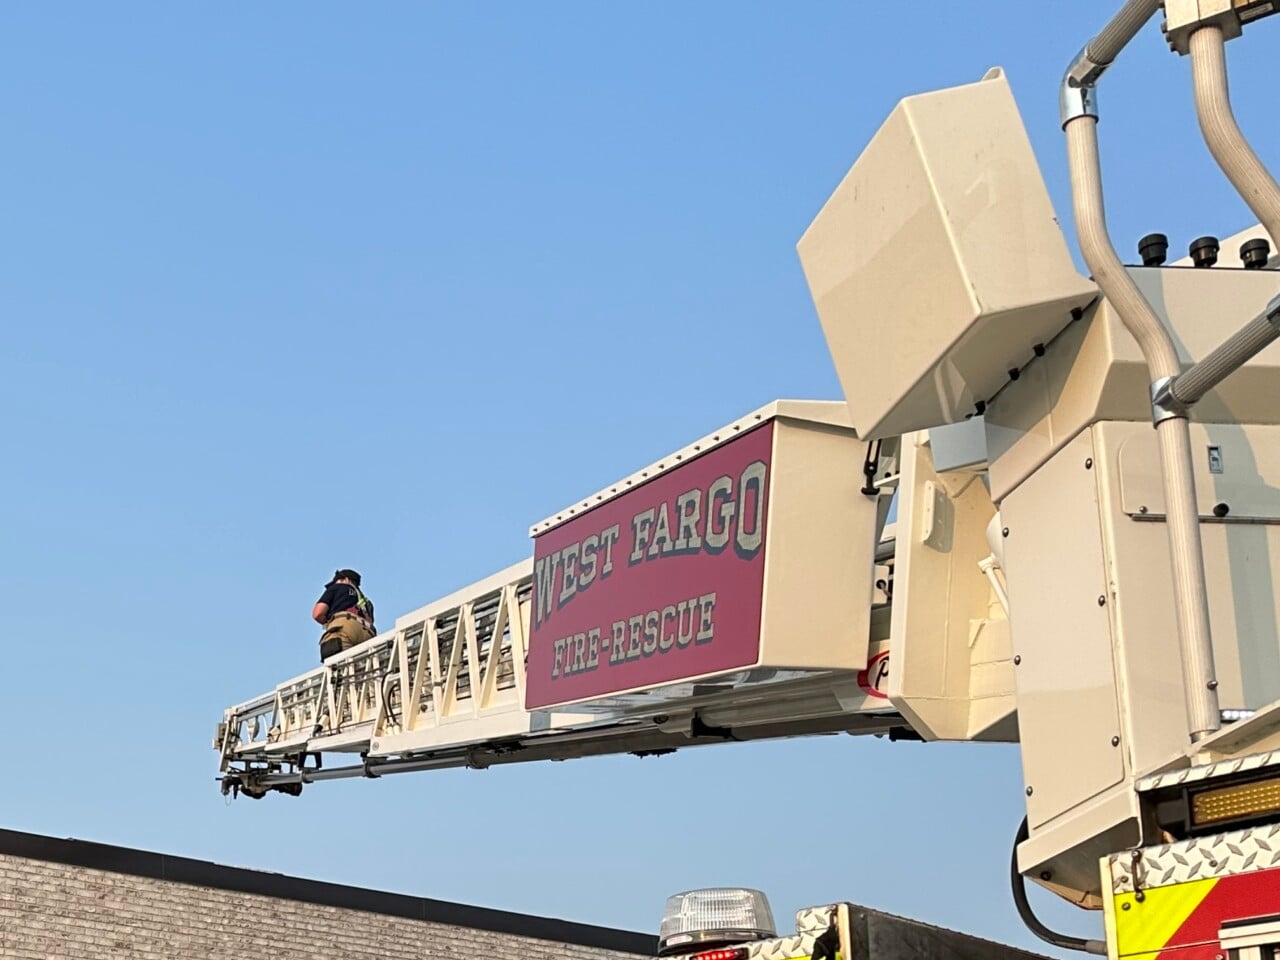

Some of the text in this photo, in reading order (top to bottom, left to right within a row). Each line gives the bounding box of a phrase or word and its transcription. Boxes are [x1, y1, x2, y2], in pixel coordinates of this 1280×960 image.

[534, 459, 768, 629] WEST FARGO
[551, 592, 716, 681] FIRE-RESCUE
